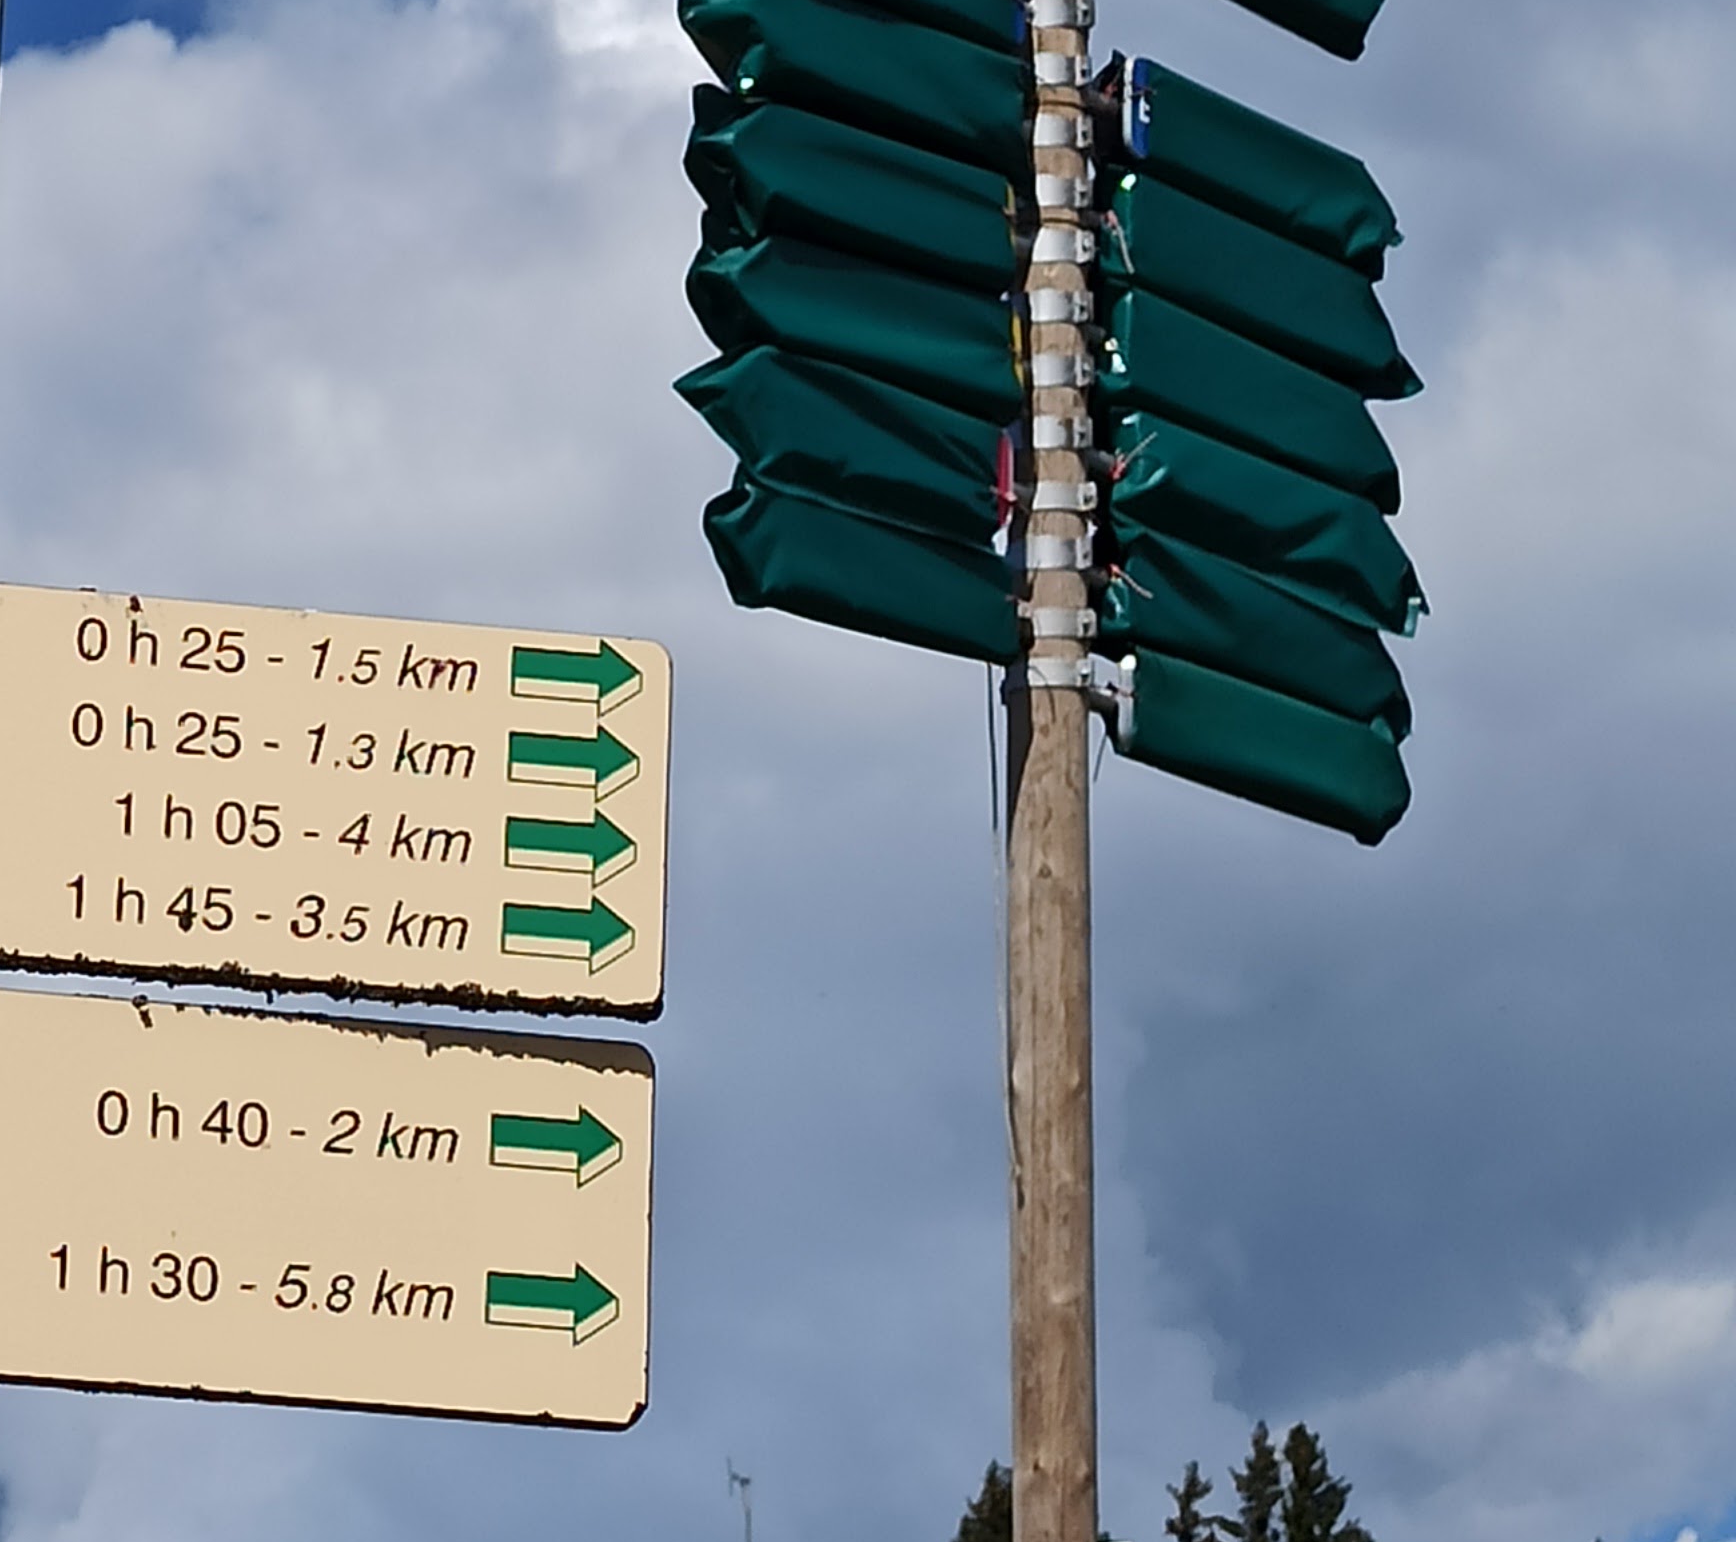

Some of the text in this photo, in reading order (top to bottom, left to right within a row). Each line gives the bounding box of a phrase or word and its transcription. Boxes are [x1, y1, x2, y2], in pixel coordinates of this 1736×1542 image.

[77, 618, 107, 661] 0
[130, 619, 157, 666] h
[180, 628, 245, 673] 25
[312, 639, 381, 684] 1.5
[398, 644, 477, 691] km
[73, 703, 103, 746] 0
[125, 705, 156, 750] h
[176, 712, 241, 759] 25
[308, 723, 376, 769] 1.3
[394, 729, 475, 778] km
[116, 793, 132, 835] 1
[164, 794, 192, 840] h
[216, 802, 281, 848] 05
[338, 814, 371, 855] 4
[391, 814, 471, 863] km
[67, 875, 83, 919] 1
[116, 877, 144, 924] h
[166, 887, 233, 932] 45
[290, 895, 369, 942] 3.5
[387, 900, 468, 950] km
[98, 1090, 128, 1135] 0
[151, 1092, 179, 1140] h
[202, 1100, 268, 1147] 40
[323, 1110, 360, 1154] 2
[377, 1112, 459, 1163] km
[50, 1245, 67, 1290] 1
[100, 1246, 128, 1294] h
[151, 1253, 218, 1302] 30
[275, 1264, 355, 1313] 5.8
[372, 1269, 453, 1320] km
